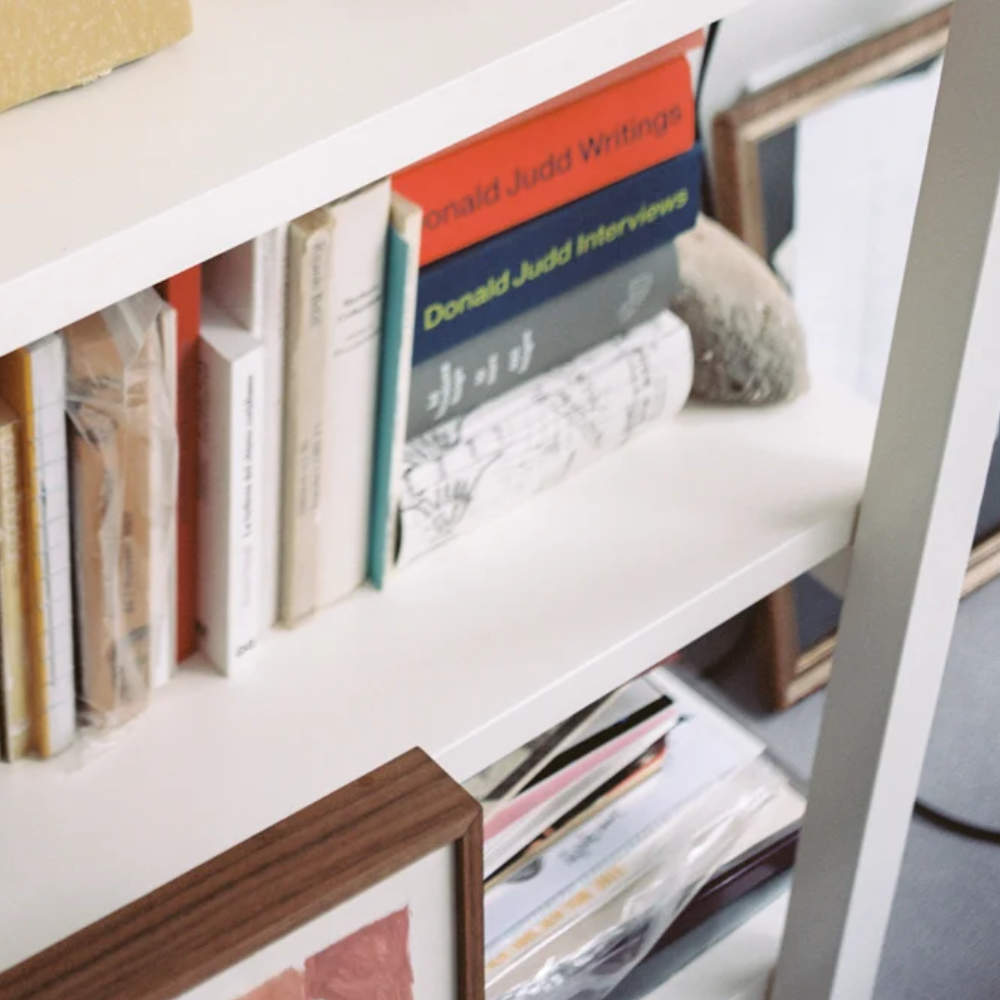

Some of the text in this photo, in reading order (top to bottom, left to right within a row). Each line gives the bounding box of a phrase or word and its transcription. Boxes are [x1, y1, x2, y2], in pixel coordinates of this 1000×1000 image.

[423, 104, 683, 231] onald Judd Writings
[423, 269, 511, 331] Donald
[513, 236, 573, 288] Judd
[576, 186, 690, 253] Interviews
